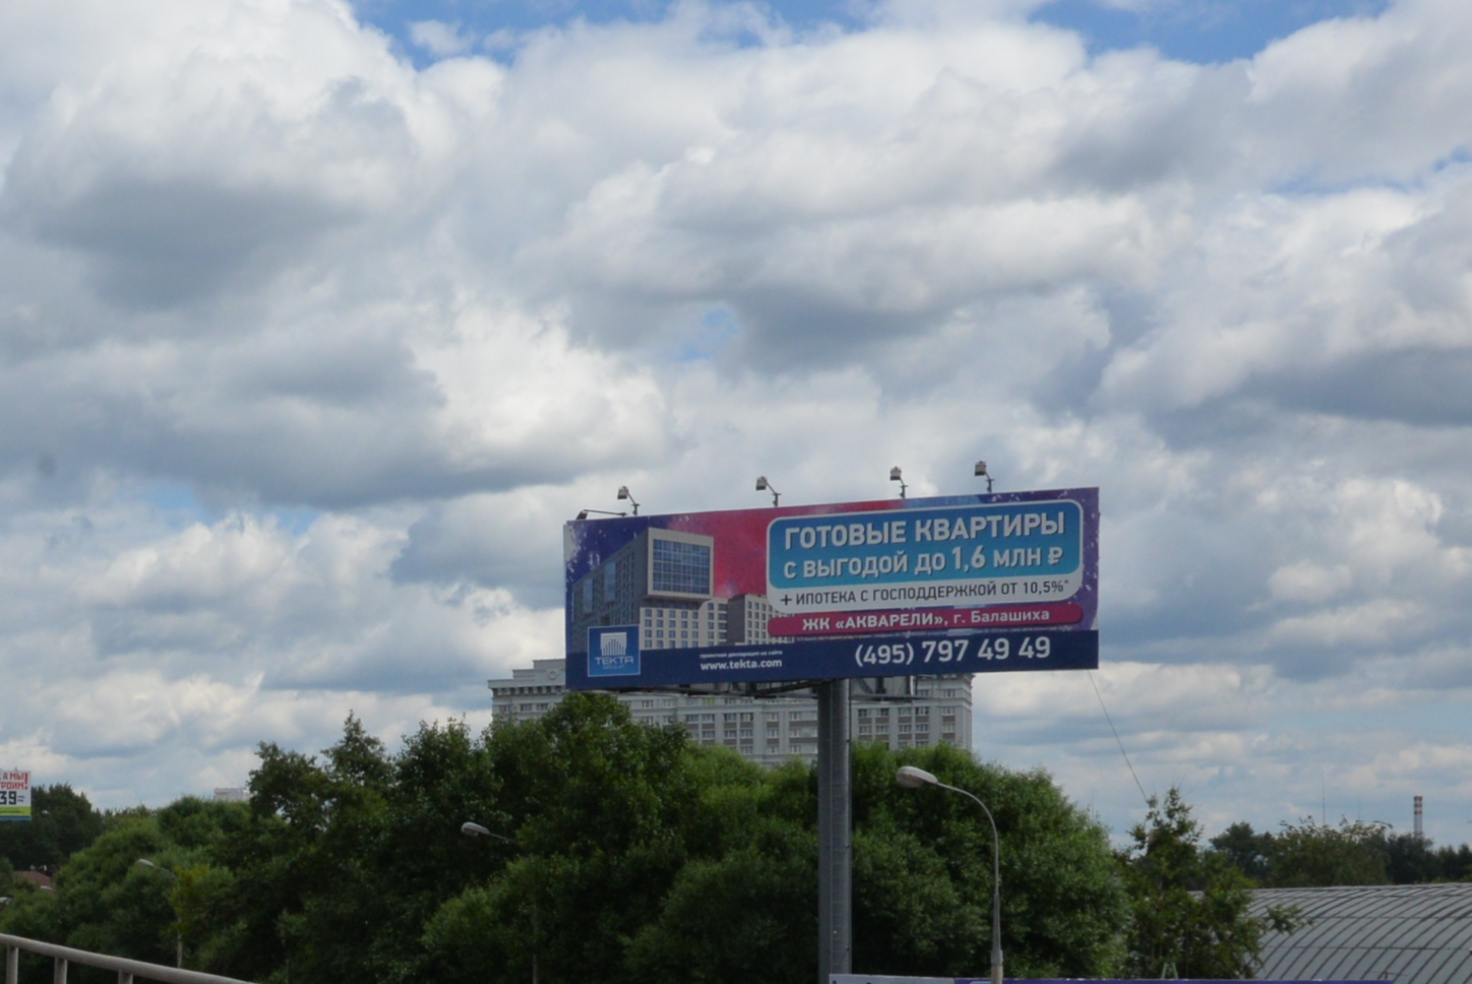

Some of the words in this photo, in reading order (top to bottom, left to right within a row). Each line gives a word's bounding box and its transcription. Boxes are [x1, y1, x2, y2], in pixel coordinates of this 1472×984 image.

[785, 521, 907, 550] ГОТОВЫЕ
[915, 511, 1065, 542] КВАРТИРЫ
[784, 561, 797, 579] С
[803, 550, 908, 579] ВЫГОДОЙ
[914, 553, 946, 575] ДО
[952, 545, 986, 573] 1,6
[993, 548, 1041, 568] МЛН
[796, 591, 856, 605] ИПОТЕКА
[860, 590, 869, 602] С
[873, 581, 996, 601] ГОСПОДДЕРЖКОЙ
[1001, 582, 1018, 595] ОТ
[802, 618, 830, 631] ЖК
[836, 613, 948, 630] «АКВАРЕЛИ»,
[953, 614, 965, 624] г.
[971, 610, 1050, 624] Балашиха
[594, 655, 634, 666] TEKTA
[855, 643, 914, 667] (495)
[922, 639, 969, 663] 797
[978, 637, 1010, 660] 49
[1018, 636, 1051, 659] 49
[700, 658, 783, 671] www.tekta.com
